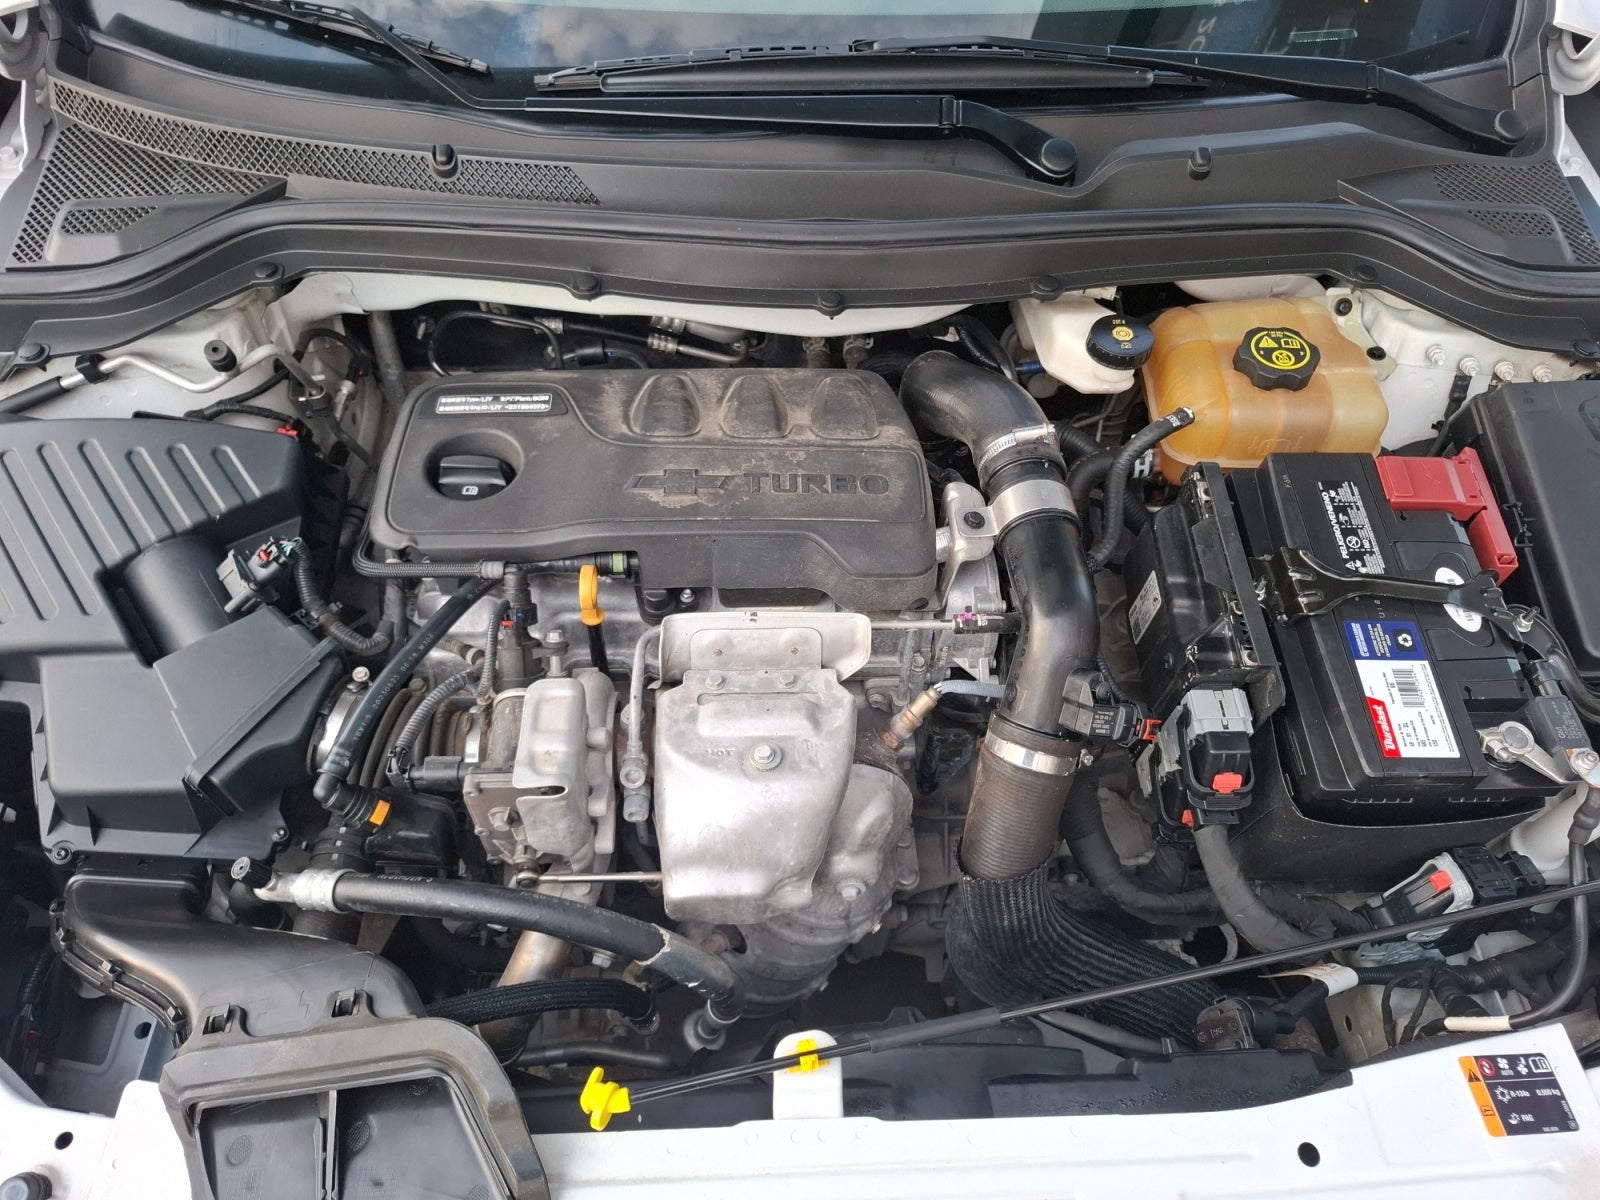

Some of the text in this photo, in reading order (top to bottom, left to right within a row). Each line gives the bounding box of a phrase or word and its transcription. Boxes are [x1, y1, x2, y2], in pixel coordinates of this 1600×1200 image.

[743, 472, 890, 496] TURBO
[1321, 491, 1350, 559] PELIGRO/VENENO
[1373, 703, 1396, 752] Duralast
